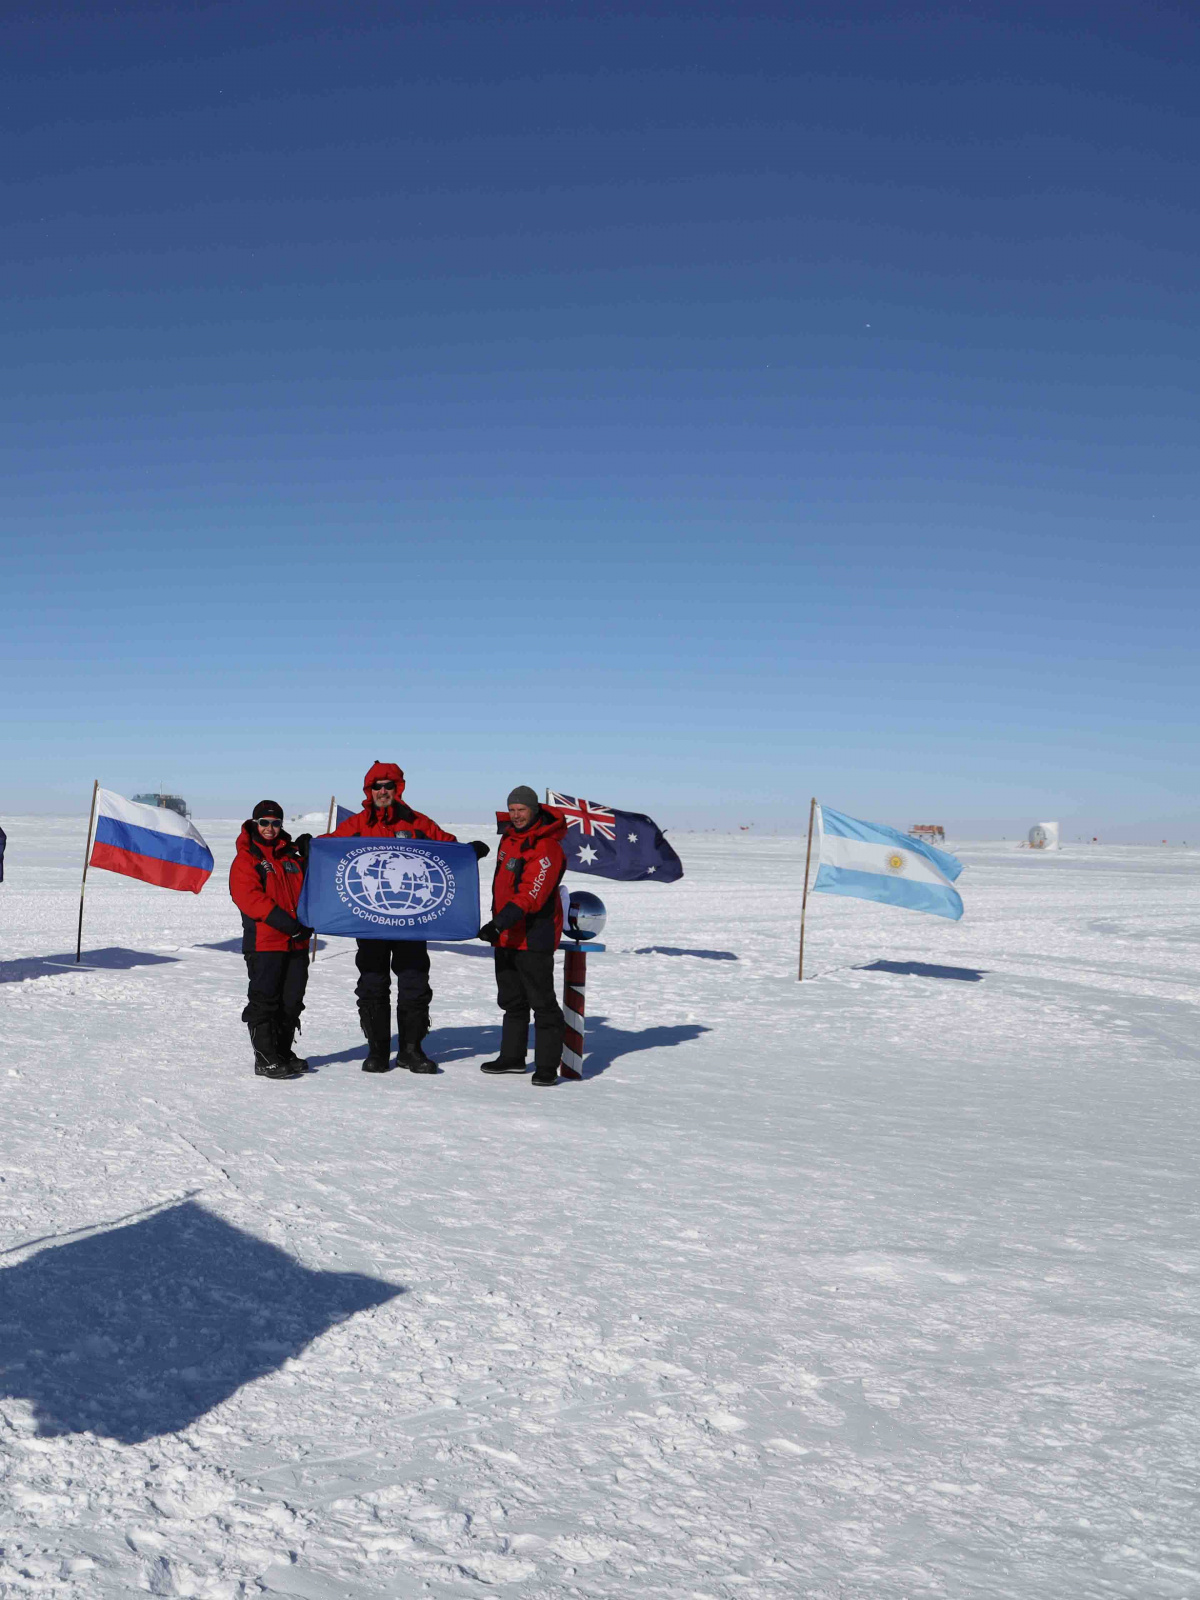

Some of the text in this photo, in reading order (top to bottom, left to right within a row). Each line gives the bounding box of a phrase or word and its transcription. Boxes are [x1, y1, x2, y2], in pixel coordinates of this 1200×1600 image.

[335, 845, 456, 906] РУССКОЕ ГЕОГРАФИЧЕСКОЕ ОБЩЕСТВО
[352, 906, 406, 927] ОСНОВАНО
[407, 917, 415, 926] В
[417, 912, 437, 925] 1845
